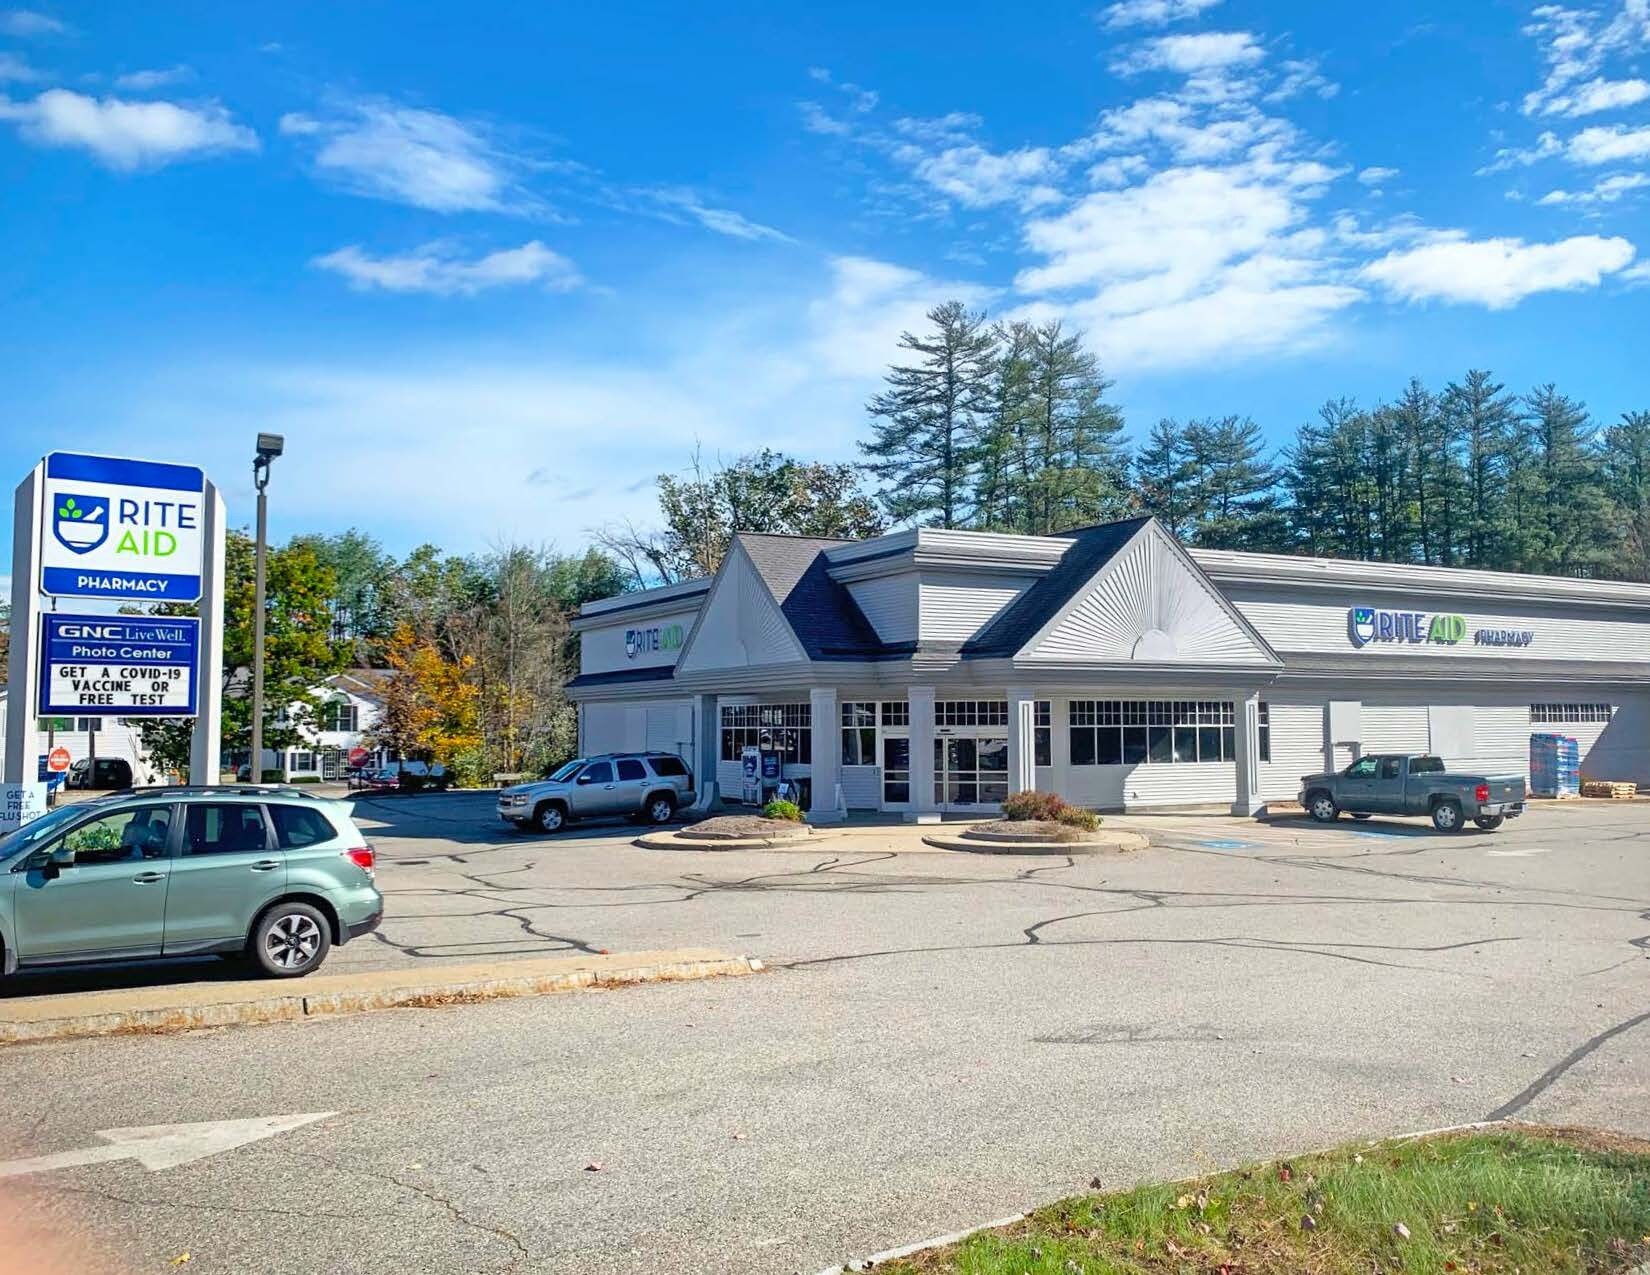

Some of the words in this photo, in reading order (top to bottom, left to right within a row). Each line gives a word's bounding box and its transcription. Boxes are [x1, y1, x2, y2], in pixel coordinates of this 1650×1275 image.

[119, 498, 197, 530] RITE
[115, 529, 177, 557] AID
[77, 575, 169, 593] PHARMACY
[58, 625, 123, 640] GNC
[1377, 612, 1426, 640] RITE
[1430, 615, 1466, 641] AID
[1479, 629, 1536, 645] PHARMACY
[636, 628, 659, 653] RITE
[662, 624, 682, 650] AID
[72, 645, 117, 658] Photo
[120, 647, 172, 659] Center
[59, 666, 87, 679] GET
[101, 667, 111, 679] A
[120, 667, 182, 680] COVID-19
[72, 680, 132, 692] VACCINE
[151, 681, 170, 693] OR
[79, 693, 114, 705] FREE
[131, 694, 165, 706] TEST
[6, 790, 26, 800] GET
[28, 791, 35, 799] A
[7, 800, 31, 810] FREE
